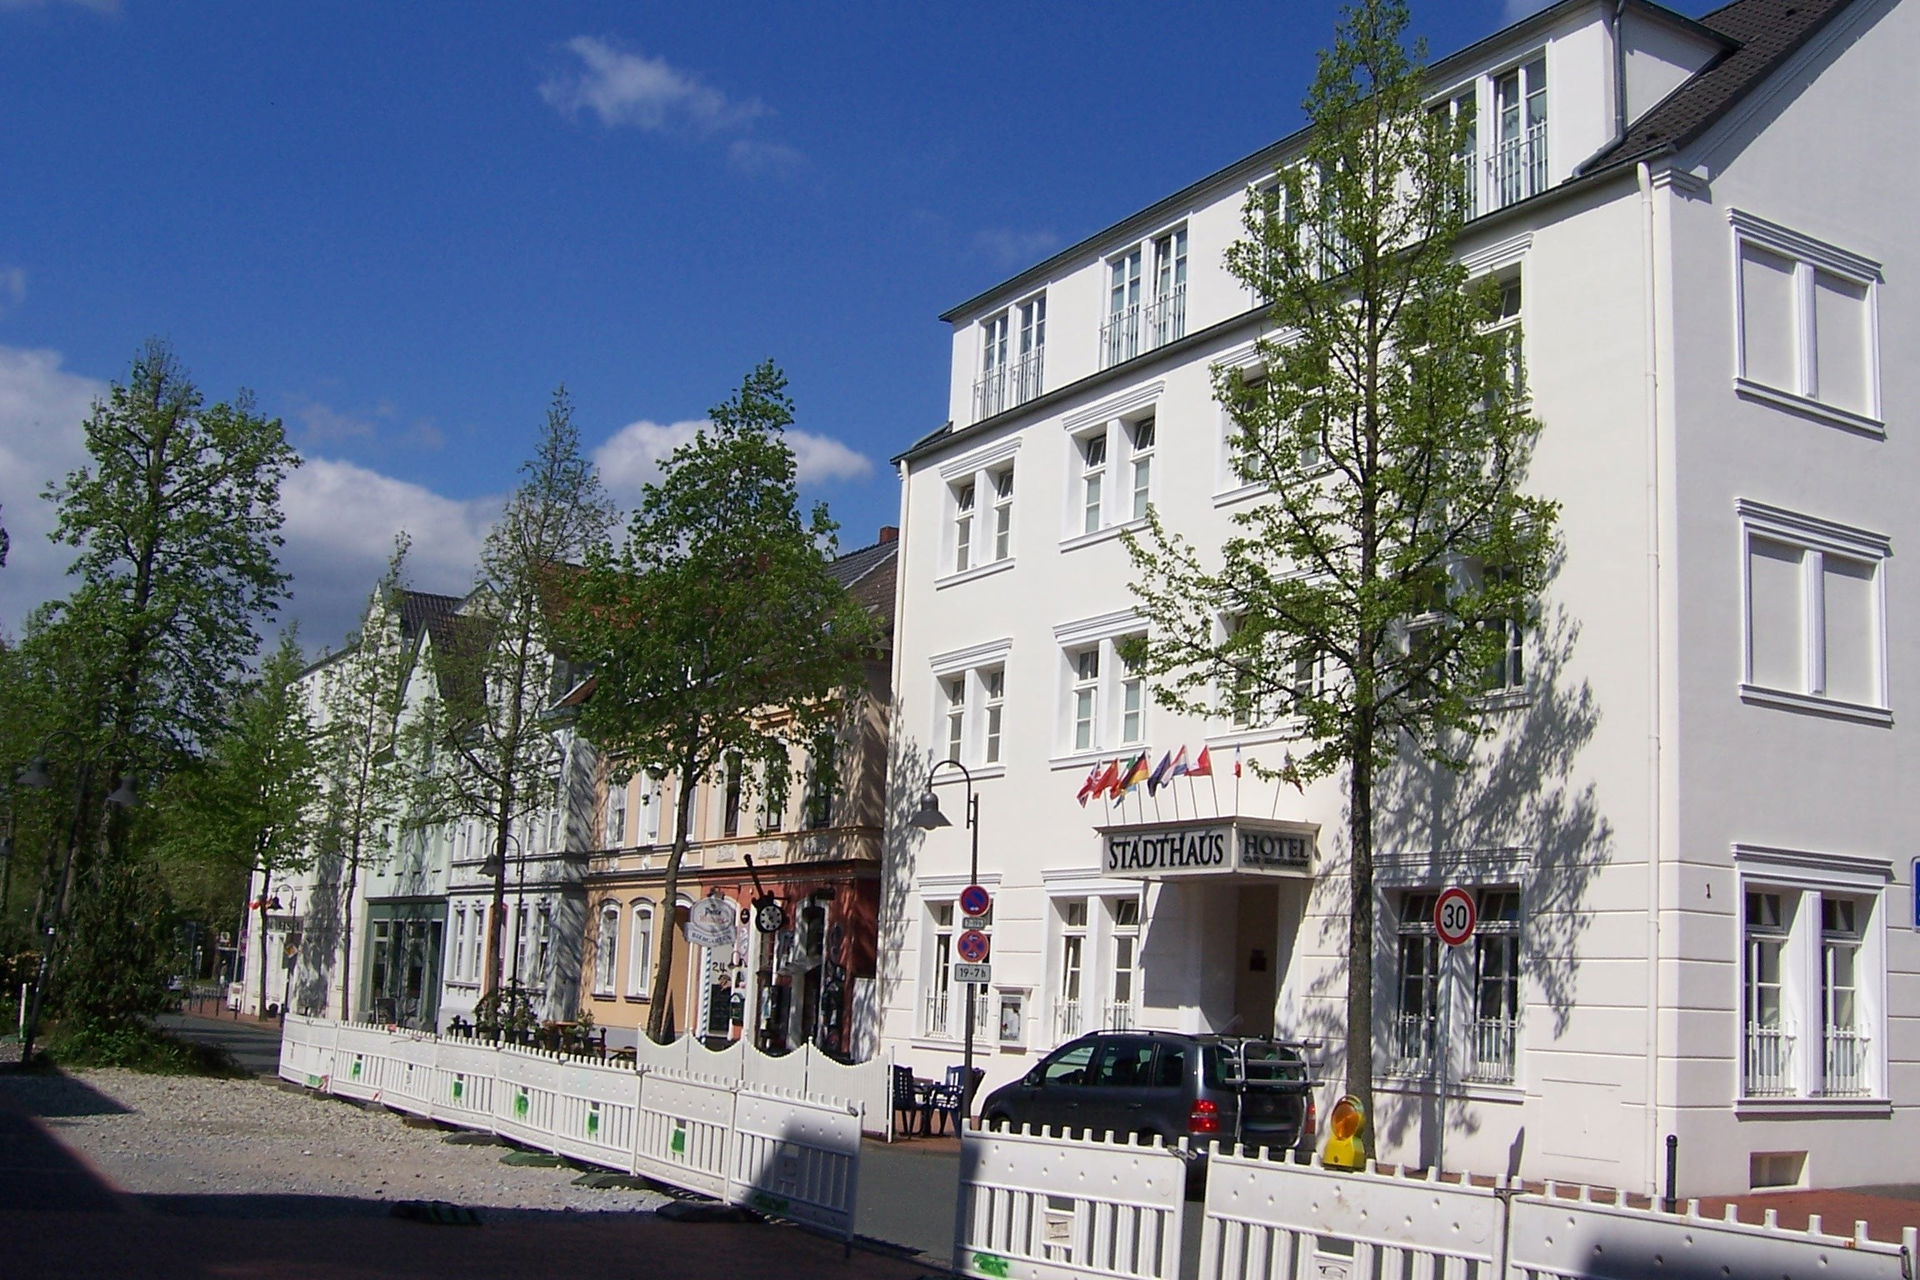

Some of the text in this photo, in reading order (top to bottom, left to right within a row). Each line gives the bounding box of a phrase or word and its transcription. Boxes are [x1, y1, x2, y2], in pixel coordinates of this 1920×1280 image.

[1109, 834, 1223, 870] STADTHAUS
[1243, 834, 1309, 858] HOTEL
[1443, 904, 1467, 930] 30
